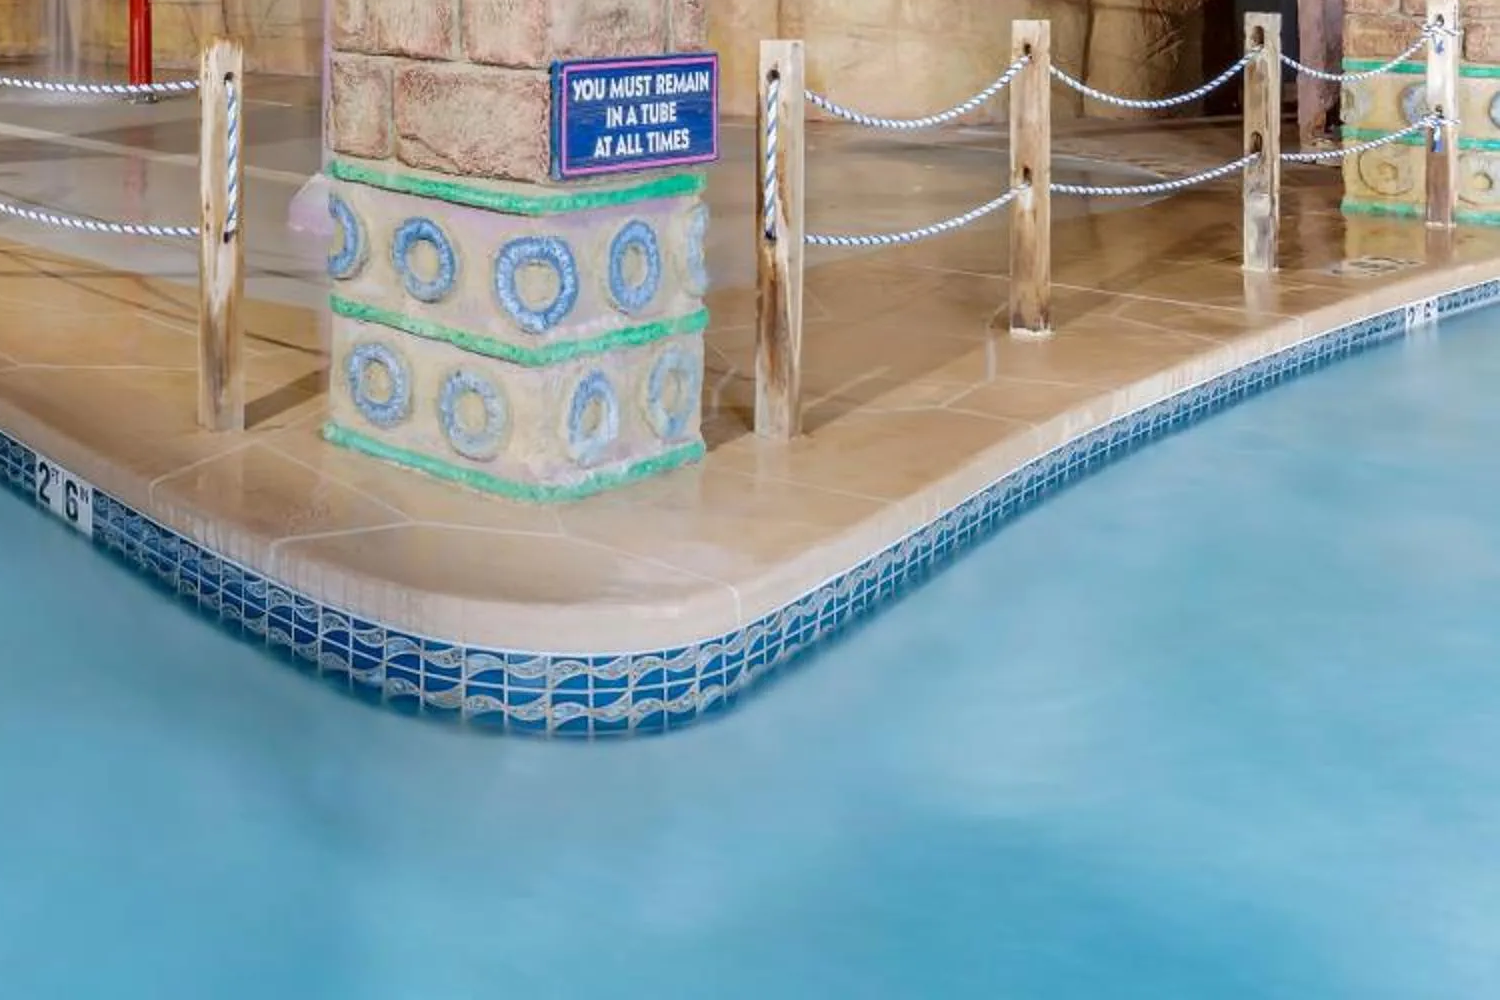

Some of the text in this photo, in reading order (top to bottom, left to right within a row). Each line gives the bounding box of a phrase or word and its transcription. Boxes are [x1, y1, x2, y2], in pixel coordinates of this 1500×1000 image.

[572, 71, 709, 102] YOU MUST REMAIN
[607, 102, 677, 129] IN A TUBE
[594, 128, 690, 158] AT ALL TIMES
